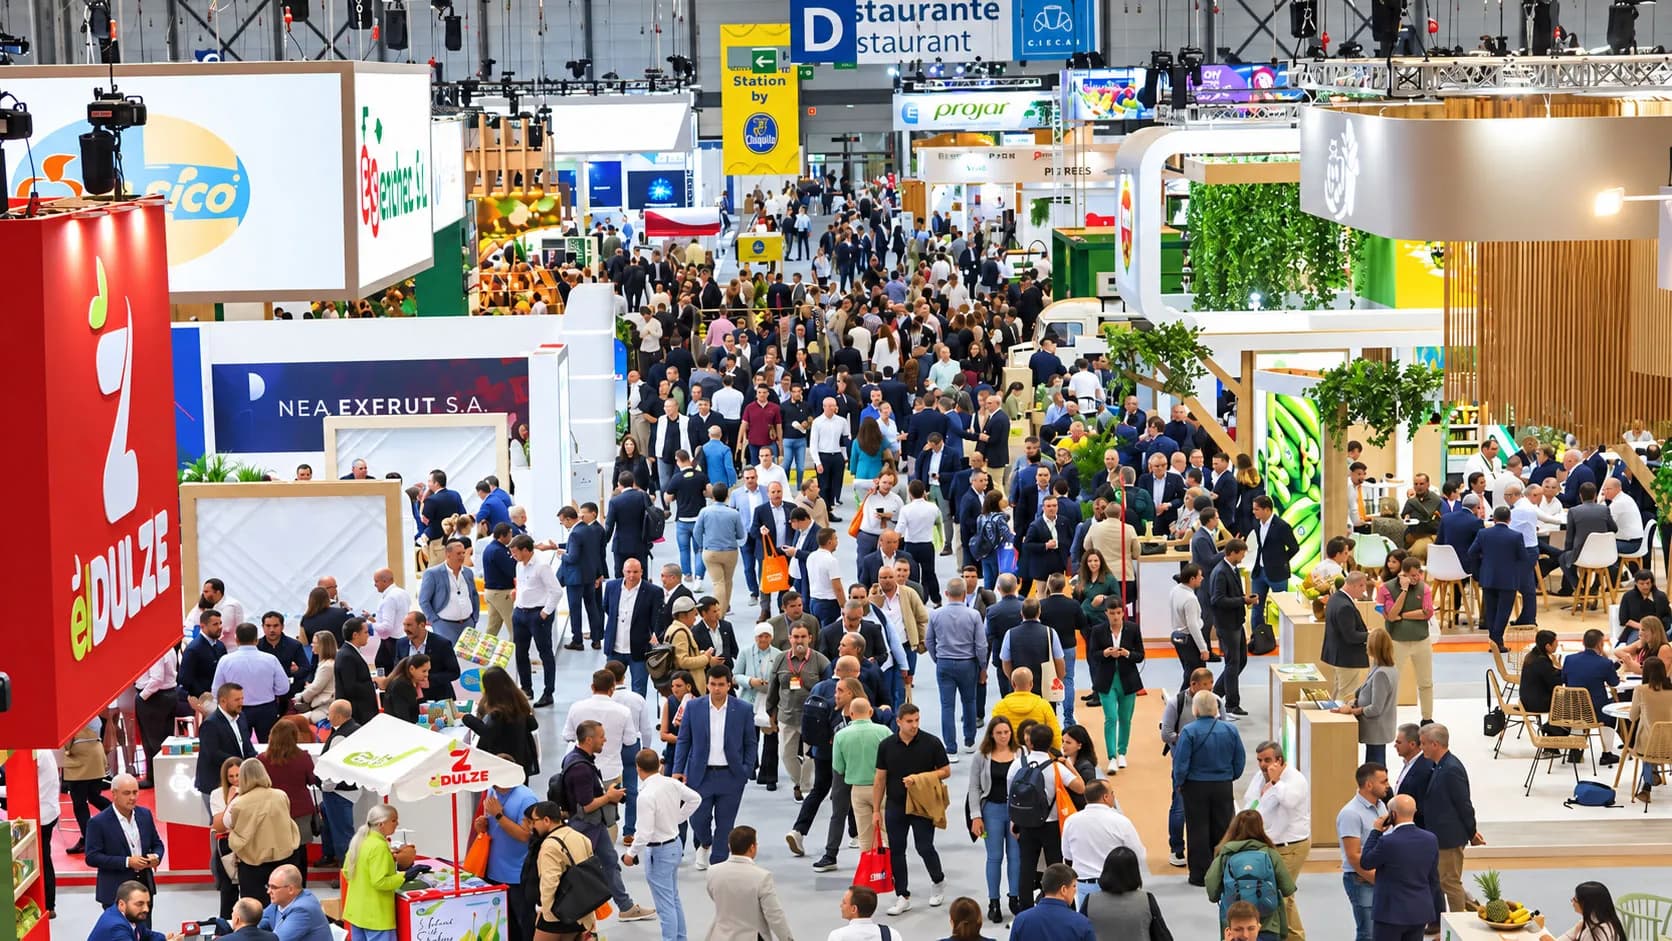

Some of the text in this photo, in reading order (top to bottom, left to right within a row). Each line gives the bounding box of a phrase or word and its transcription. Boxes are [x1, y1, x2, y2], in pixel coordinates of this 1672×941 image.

[804, 7, 843, 52] D
[734, 76, 786, 86] Station
[752, 91, 768, 104] by
[934, 102, 1011, 121] projar
[279, 396, 488, 417] NEA EXFRUT S.A.
